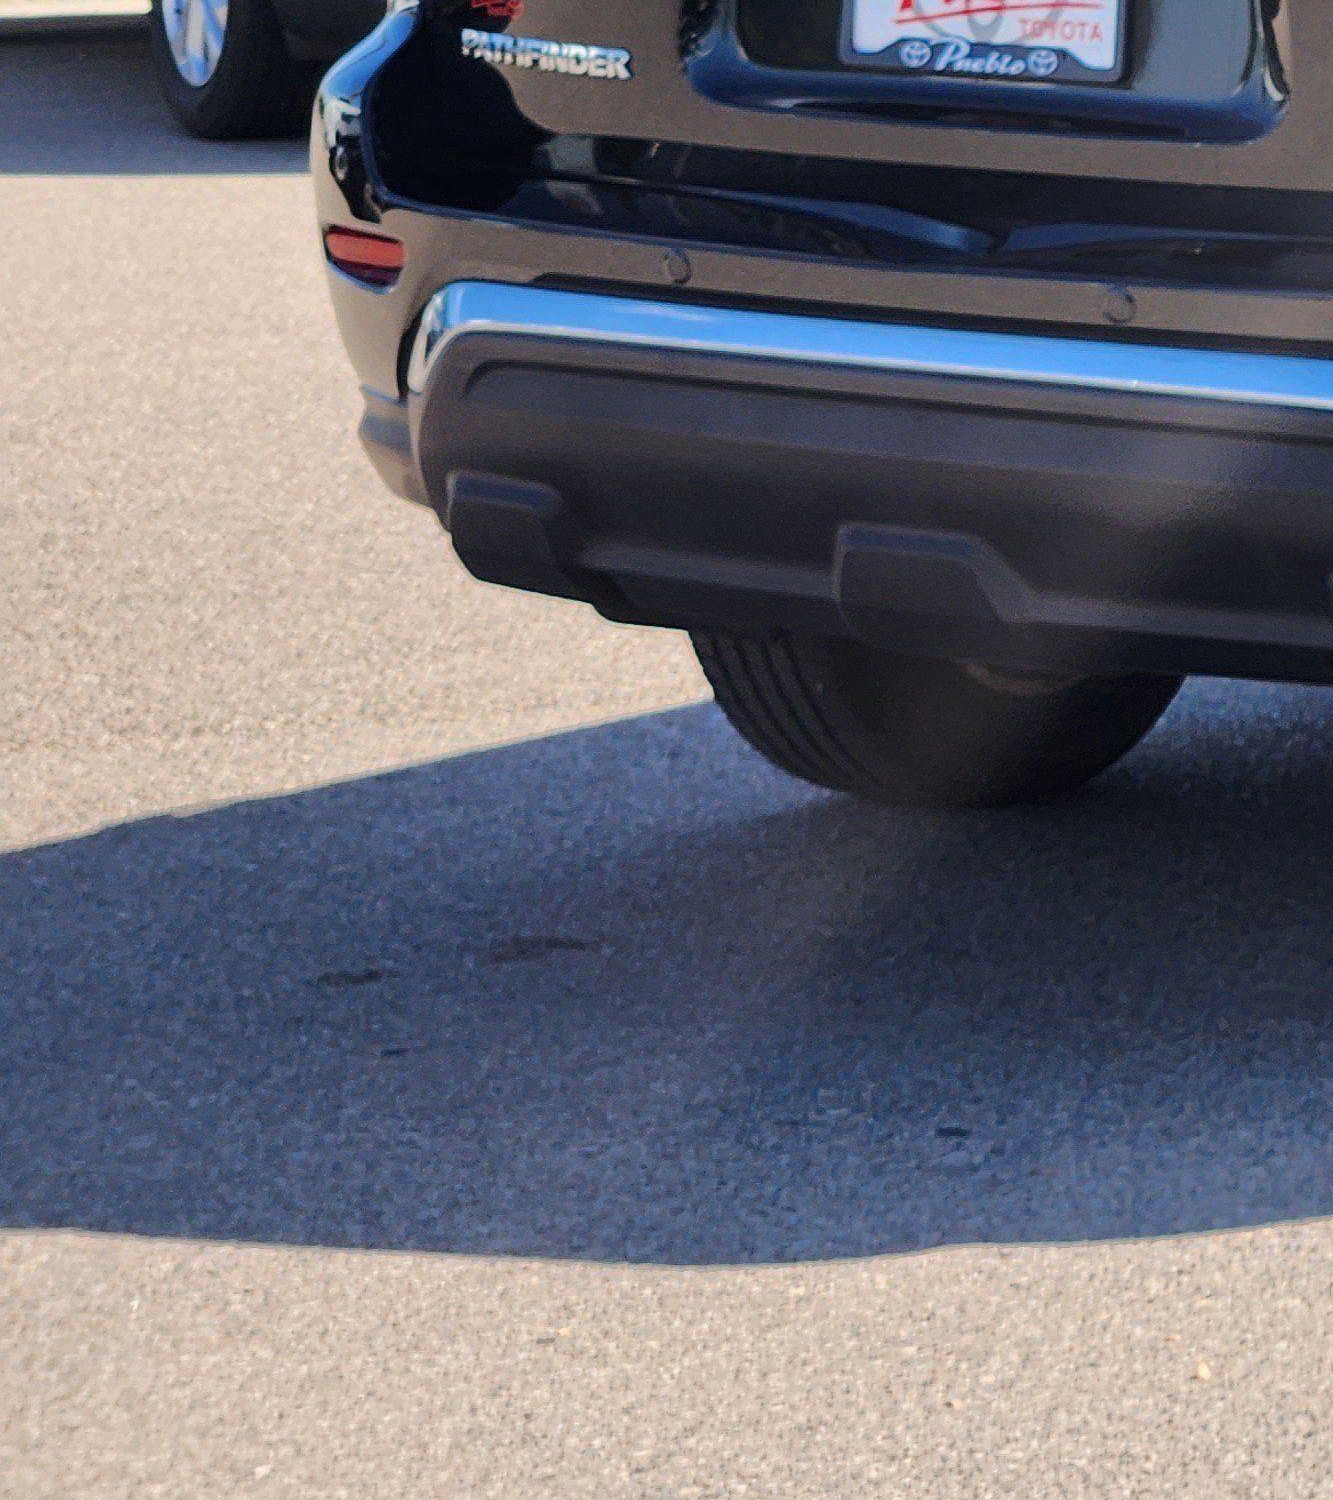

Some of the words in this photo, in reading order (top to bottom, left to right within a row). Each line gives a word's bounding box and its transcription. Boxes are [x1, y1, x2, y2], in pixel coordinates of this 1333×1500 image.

[1019, 18, 1105, 43] TOYOTA
[461, 28, 635, 81] PATHFINDER
[932, 38, 1027, 77] Pueblo
